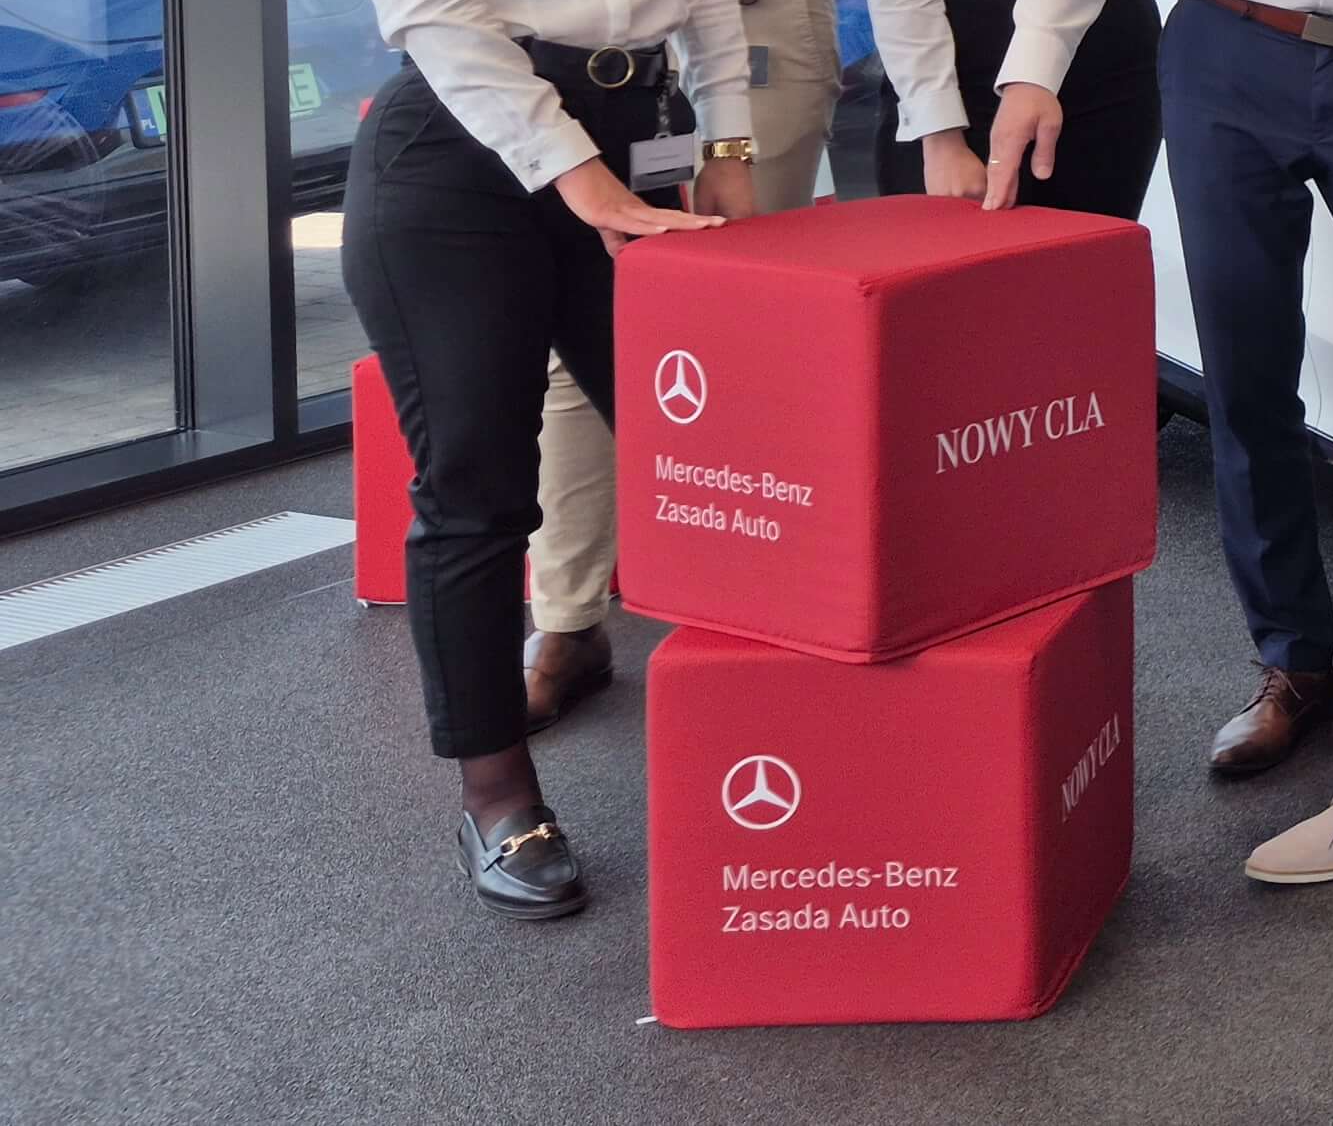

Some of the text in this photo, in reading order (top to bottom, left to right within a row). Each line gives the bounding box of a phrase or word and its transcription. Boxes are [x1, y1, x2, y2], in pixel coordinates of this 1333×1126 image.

[935, 391, 1105, 475] NOWY CLA
[655, 453, 814, 508] Mercedes-Benz
[655, 495, 780, 542] Zasada Auto
[1061, 711, 1121, 825] NOWY CLA
[721, 861, 959, 891] Mercedes-Benz
[721, 901, 910, 934] Zasada Auto
